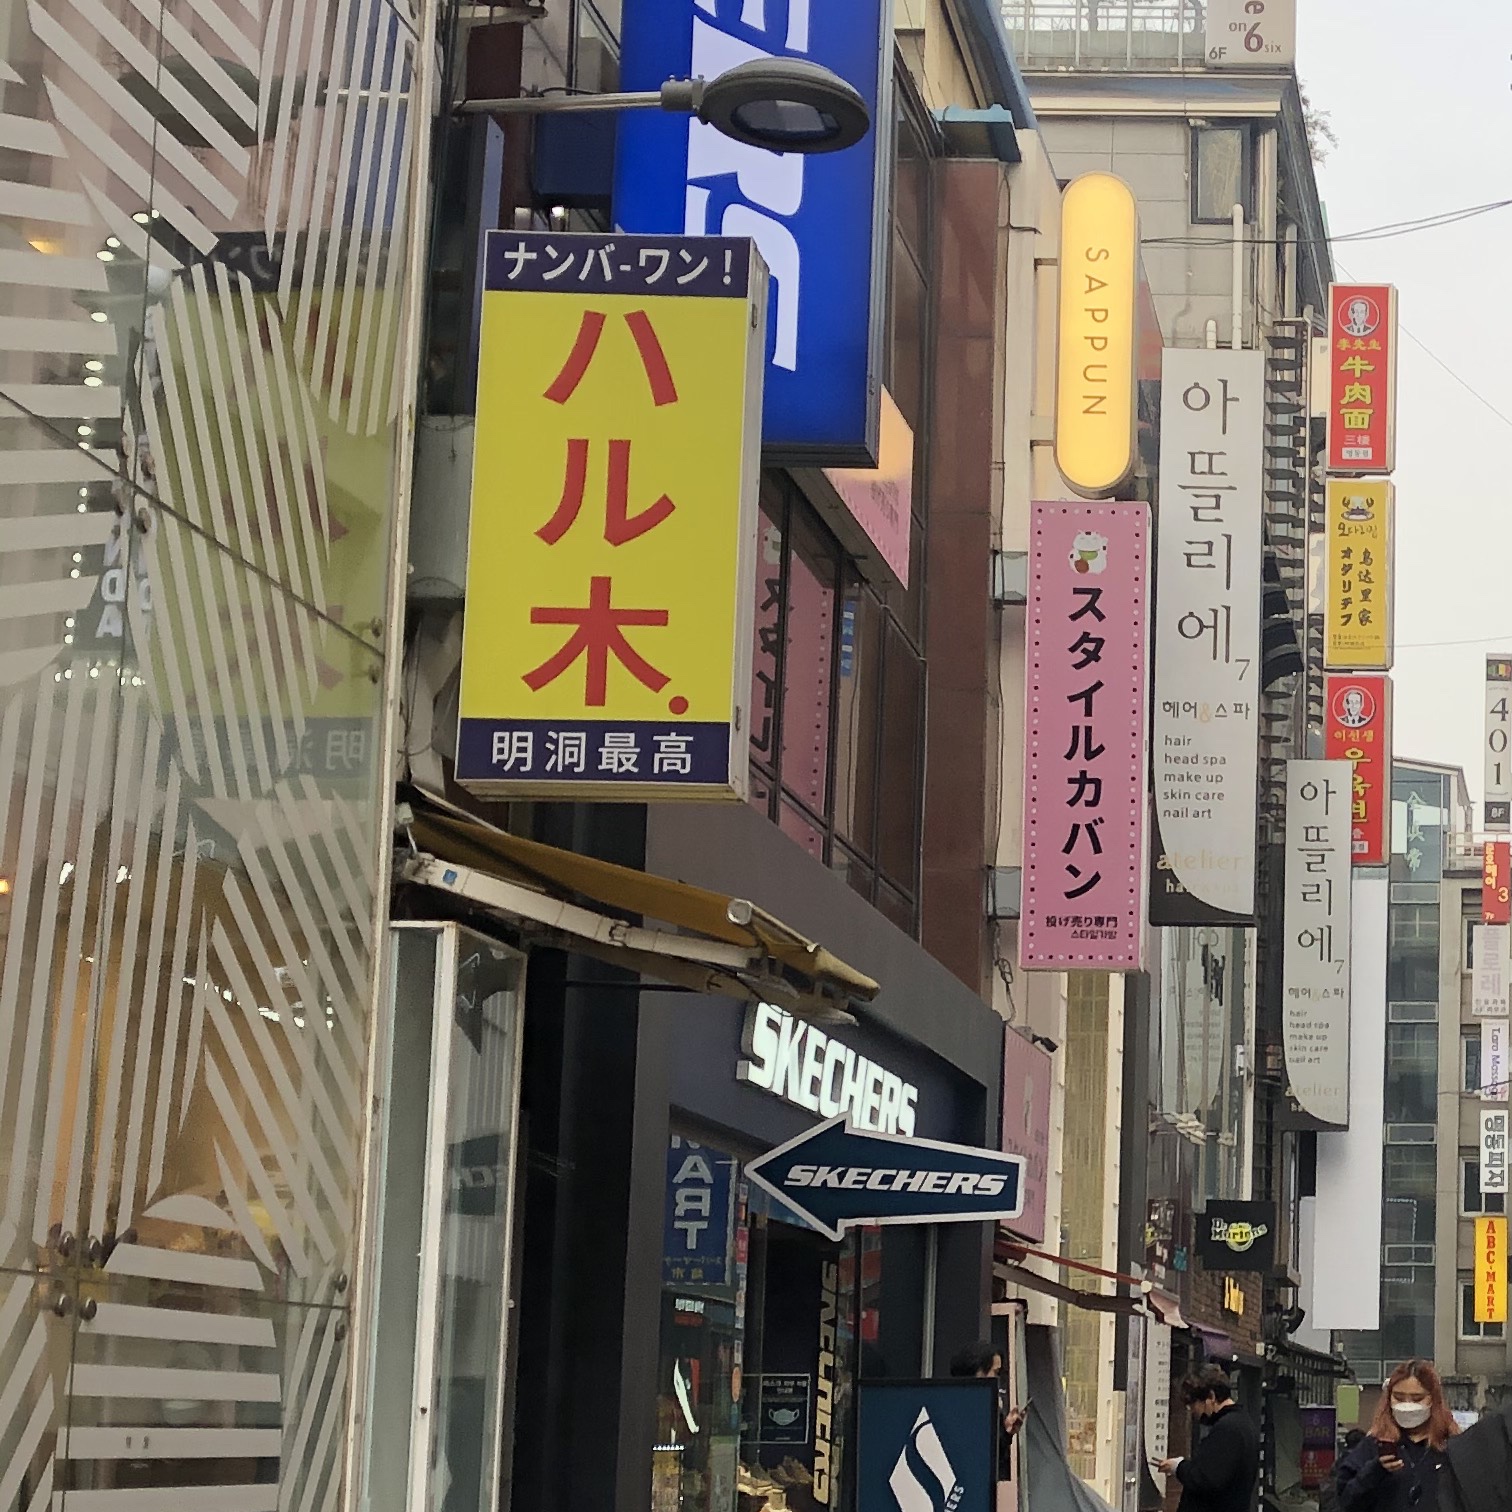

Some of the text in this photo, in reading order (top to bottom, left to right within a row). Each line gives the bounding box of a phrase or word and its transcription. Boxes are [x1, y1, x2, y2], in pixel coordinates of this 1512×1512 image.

[1208, 46, 1227, 60] 6F
[1264, 41, 1282, 53] six
[1082, 246, 1110, 416] SAPPUN
[1340, 355, 1375, 430] 牛肉面
[1177, 379, 1240, 664] 아뜰리에
[1062, 585, 1106, 900] スタイルカバン
[1164, 735, 1192, 746] hair
[491, 731, 693, 775] 明洞最高
[1164, 754, 1227, 767] head spa
[1163, 772, 1224, 785] make up
[1163, 789, 1225, 801] skin care
[1163, 807, 1212, 818] nail art
[1297, 779, 1337, 963] 아뜰리에
[1045, 915, 1118, 929] 投げ売り専門
[1289, 1021, 1312, 1029] head
[1289, 1033, 1328, 1042] make up
[748, 1001, 919, 1138] SKECHERS
[783, 1165, 1009, 1196] SKECHERS
